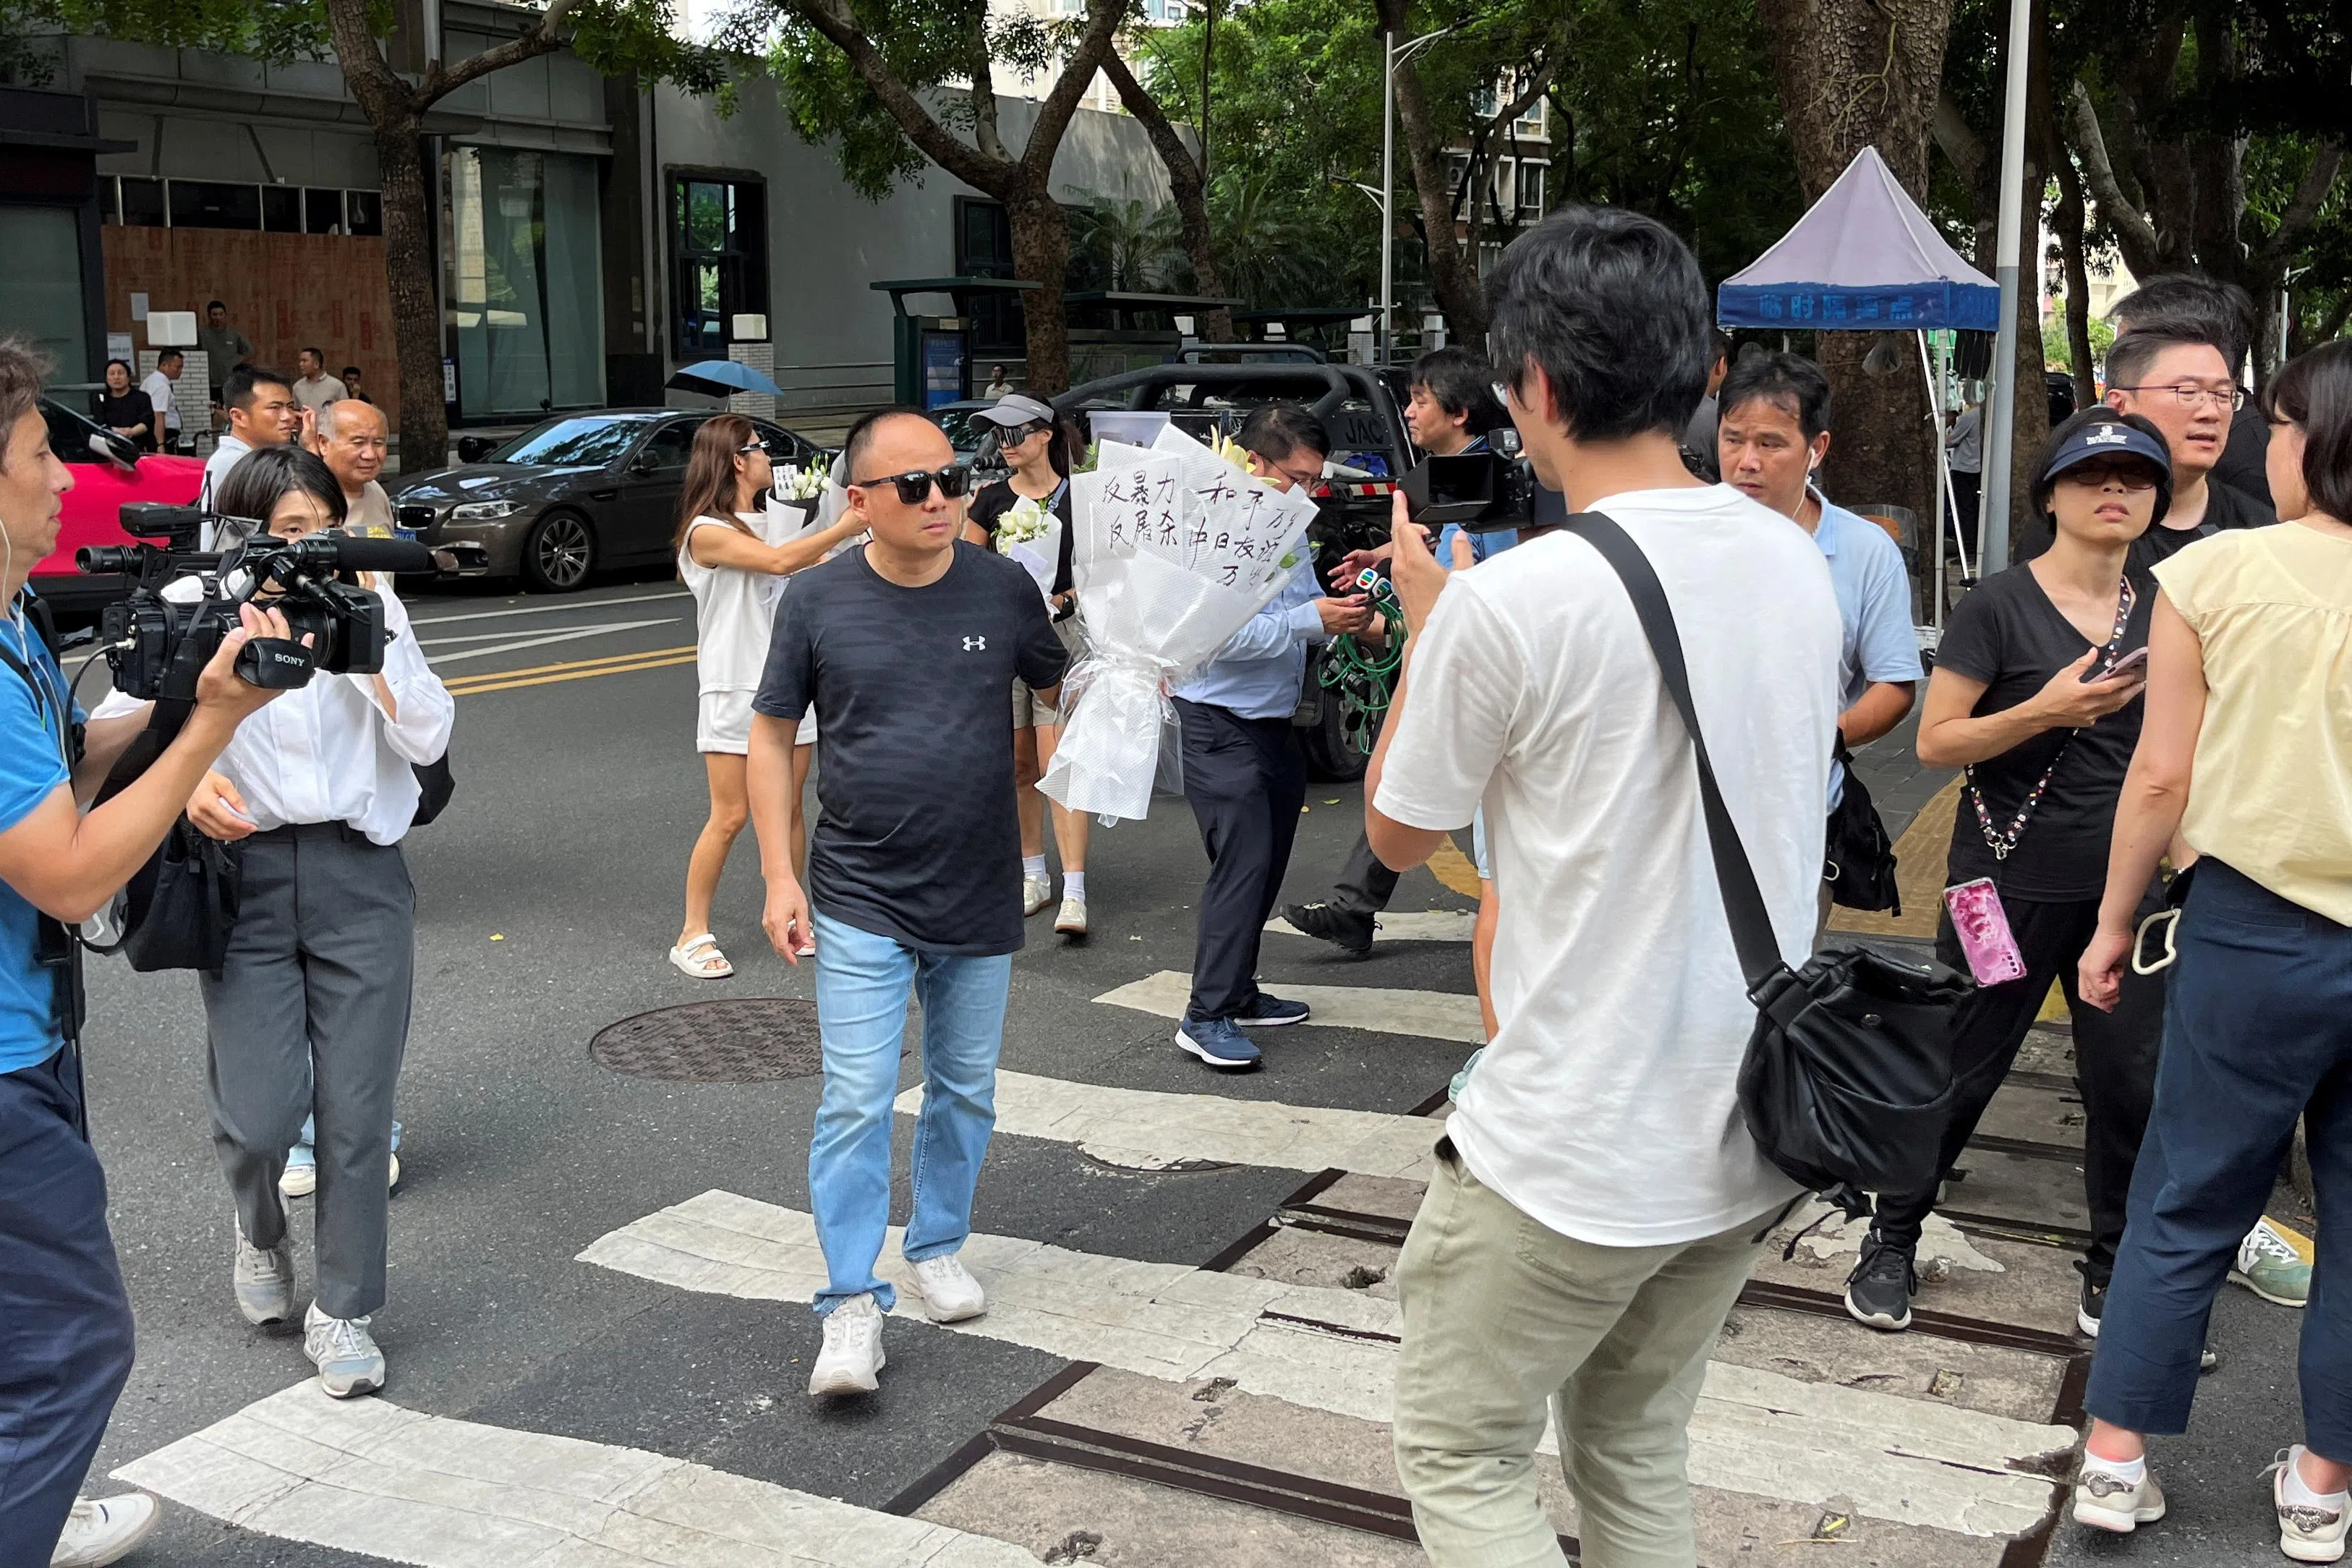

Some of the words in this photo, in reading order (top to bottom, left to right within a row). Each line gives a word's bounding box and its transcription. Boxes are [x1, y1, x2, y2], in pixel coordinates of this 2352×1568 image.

[1345, 417, 1384, 445] JAC
[1102, 470, 1175, 504] 反暴力
[1110, 509, 1177, 549] 反屠杀
[1188, 516, 1279, 571] 中日友谊
[275, 653, 305, 667] SONY
